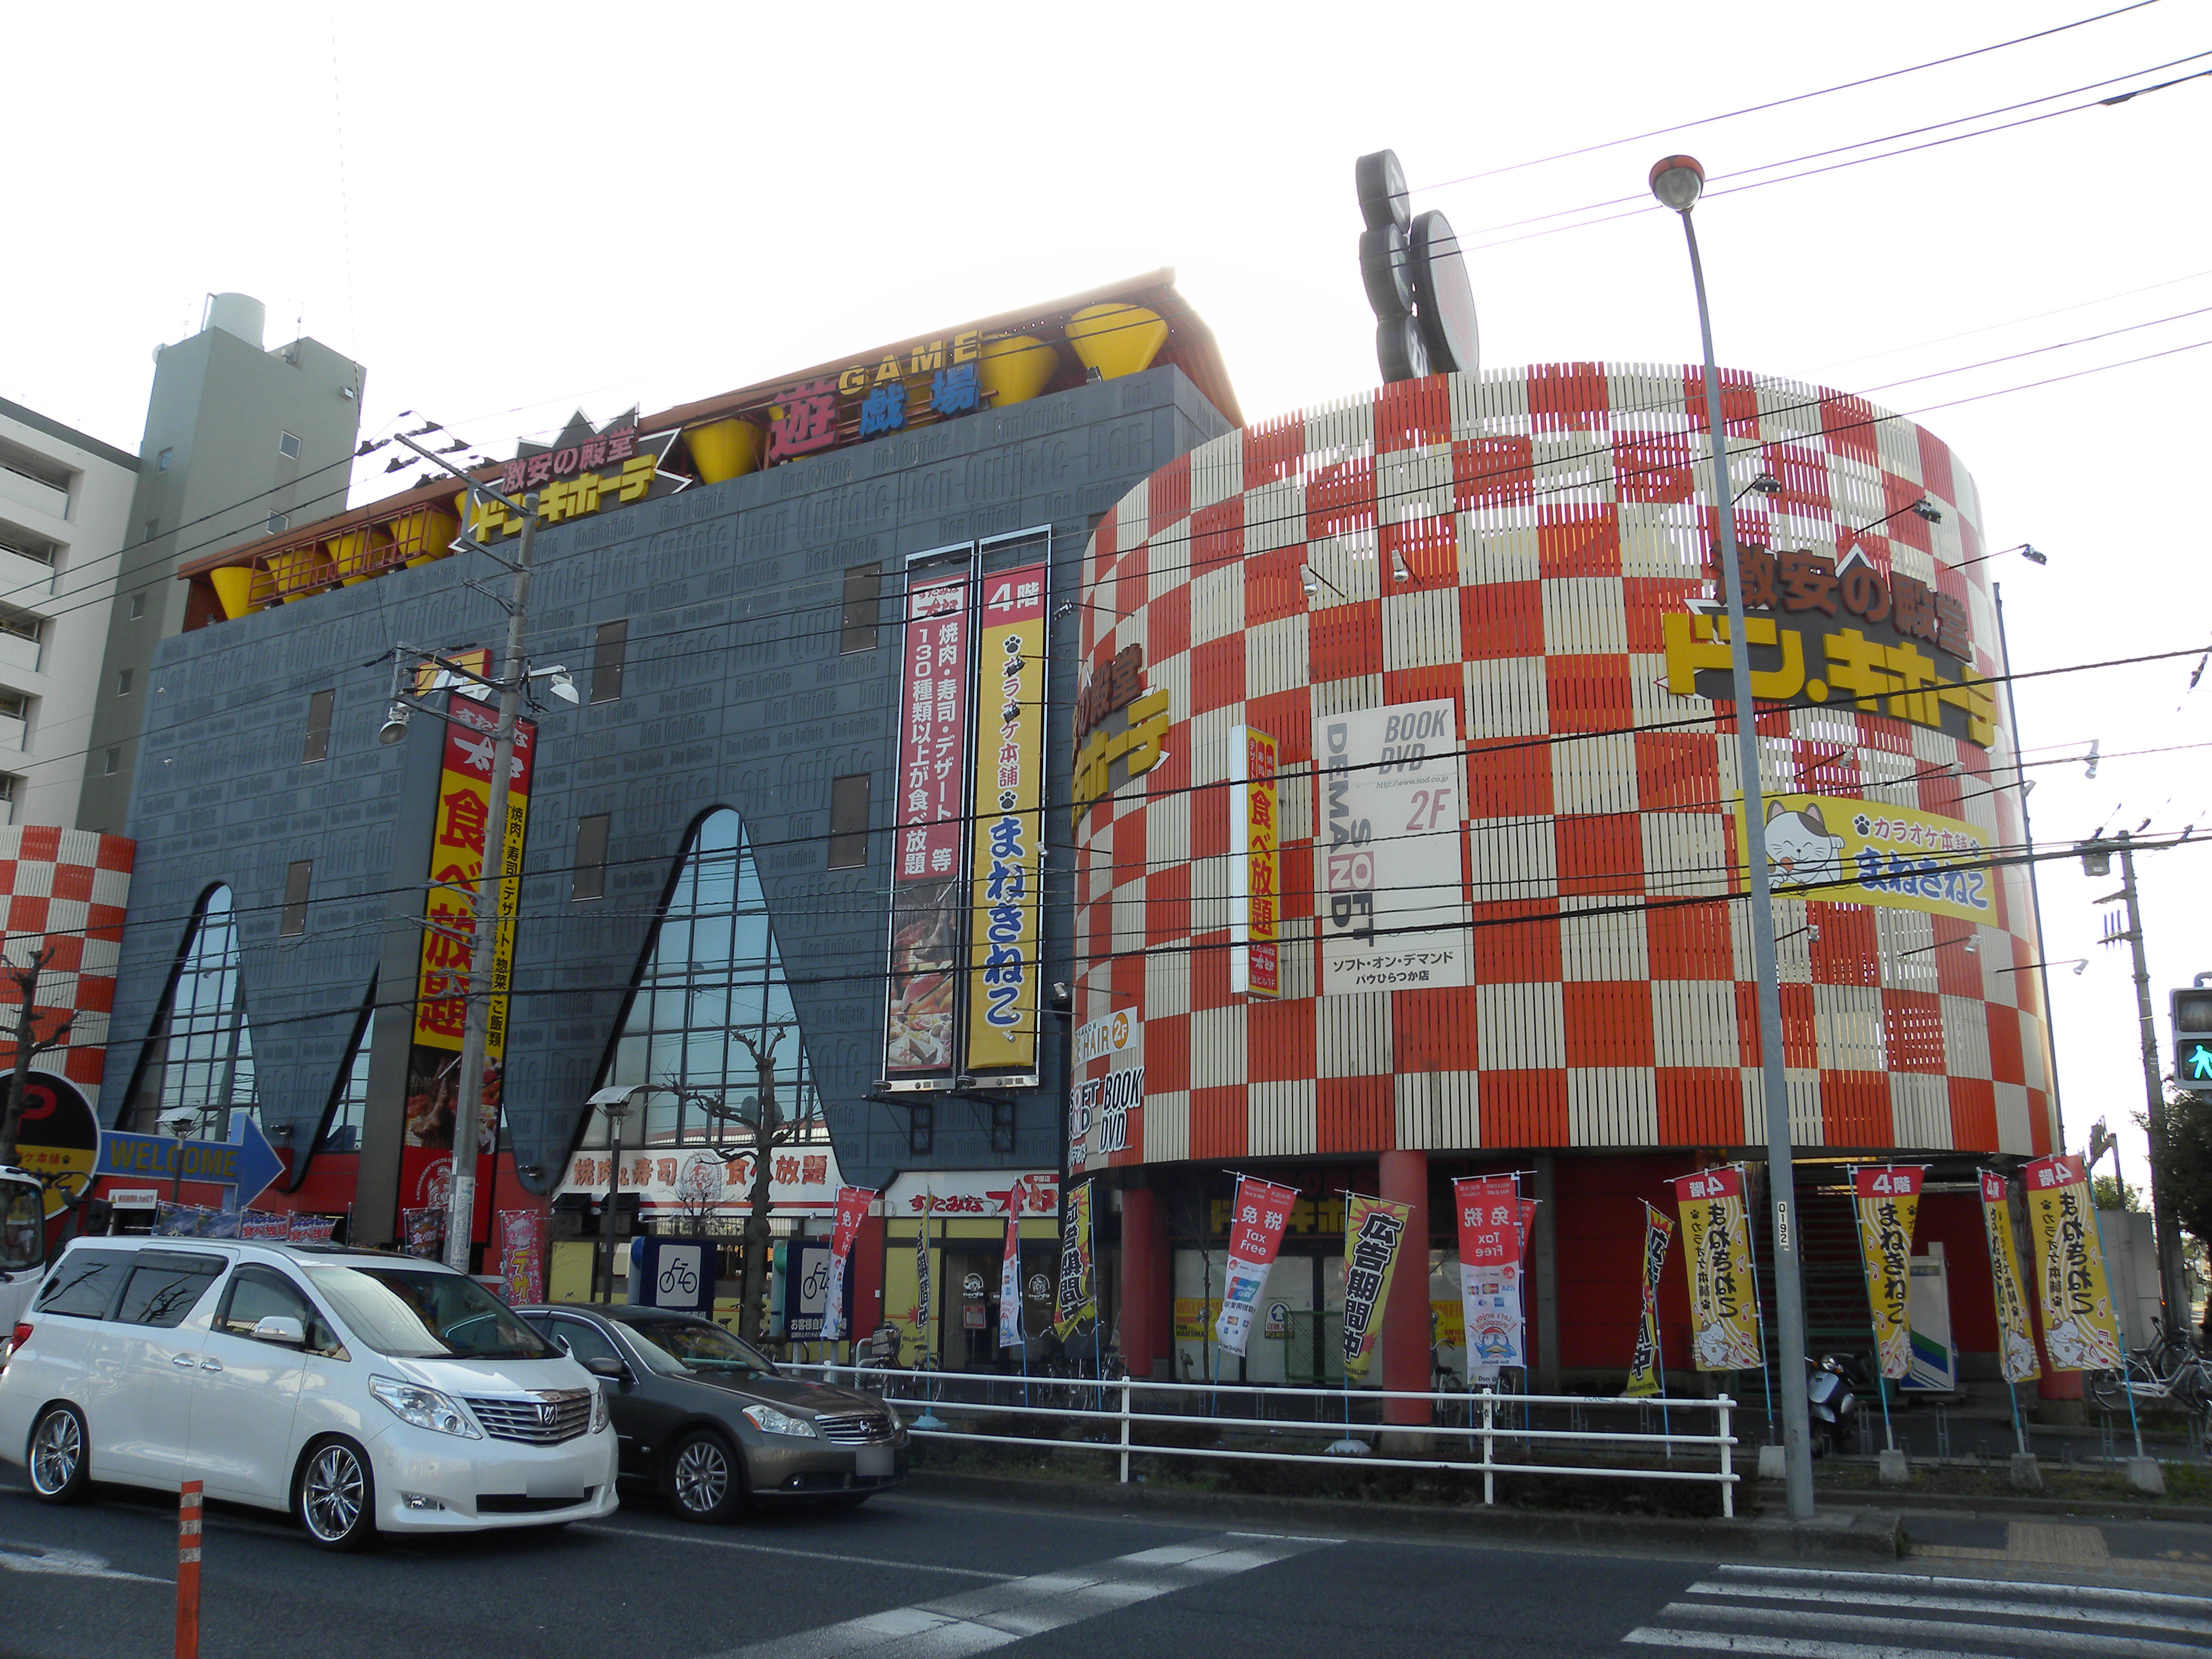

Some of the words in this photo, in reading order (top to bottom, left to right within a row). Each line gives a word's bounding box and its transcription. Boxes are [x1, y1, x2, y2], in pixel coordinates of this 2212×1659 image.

[839, 330, 982, 395] GAME
[501, 427, 635, 493] 激安の殿堂
[476, 454, 657, 543] ドンキホーテ
[988, 582, 1040, 612] 4階
[1709, 540, 1973, 662] 激安の殿堂
[456, 708, 530, 749] すたな
[1384, 709, 1448, 743] BOOK
[1379, 743, 1425, 775] DVD
[1406, 789, 1451, 832] 2F
[1872, 817, 1968, 855] カラオケ本舗
[932, 848, 952, 872] 等
[1251, 790, 1274, 937] 食べ放題
[1855, 847, 1988, 909] まねきねこ
[419, 788, 489, 1039] 食べ放題
[984, 816, 1024, 1027] まねきねこ
[1333, 951, 1454, 973] ソフト・オン・デマンド
[1083, 1025, 1109, 1058] HAIR
[1113, 1020, 1128, 1041] 2F
[1103, 1066, 1145, 1113] BOOK
[1098, 1109, 1127, 1154] DVD
[109, 1139, 238, 1177] WELCOME
[909, 1194, 985, 1213] すたみな
[1871, 1173, 1911, 1194] 4階
[1240, 1204, 1283, 1231] 免税
[1246, 1228, 1266, 1244] Tax
[1778, 1203, 1787, 1243] 0192
[1240, 1239, 1266, 1256] Free
[1877, 1203, 1906, 1324] まねきねこ
[1344, 1212, 1404, 1363] 広告期間中
